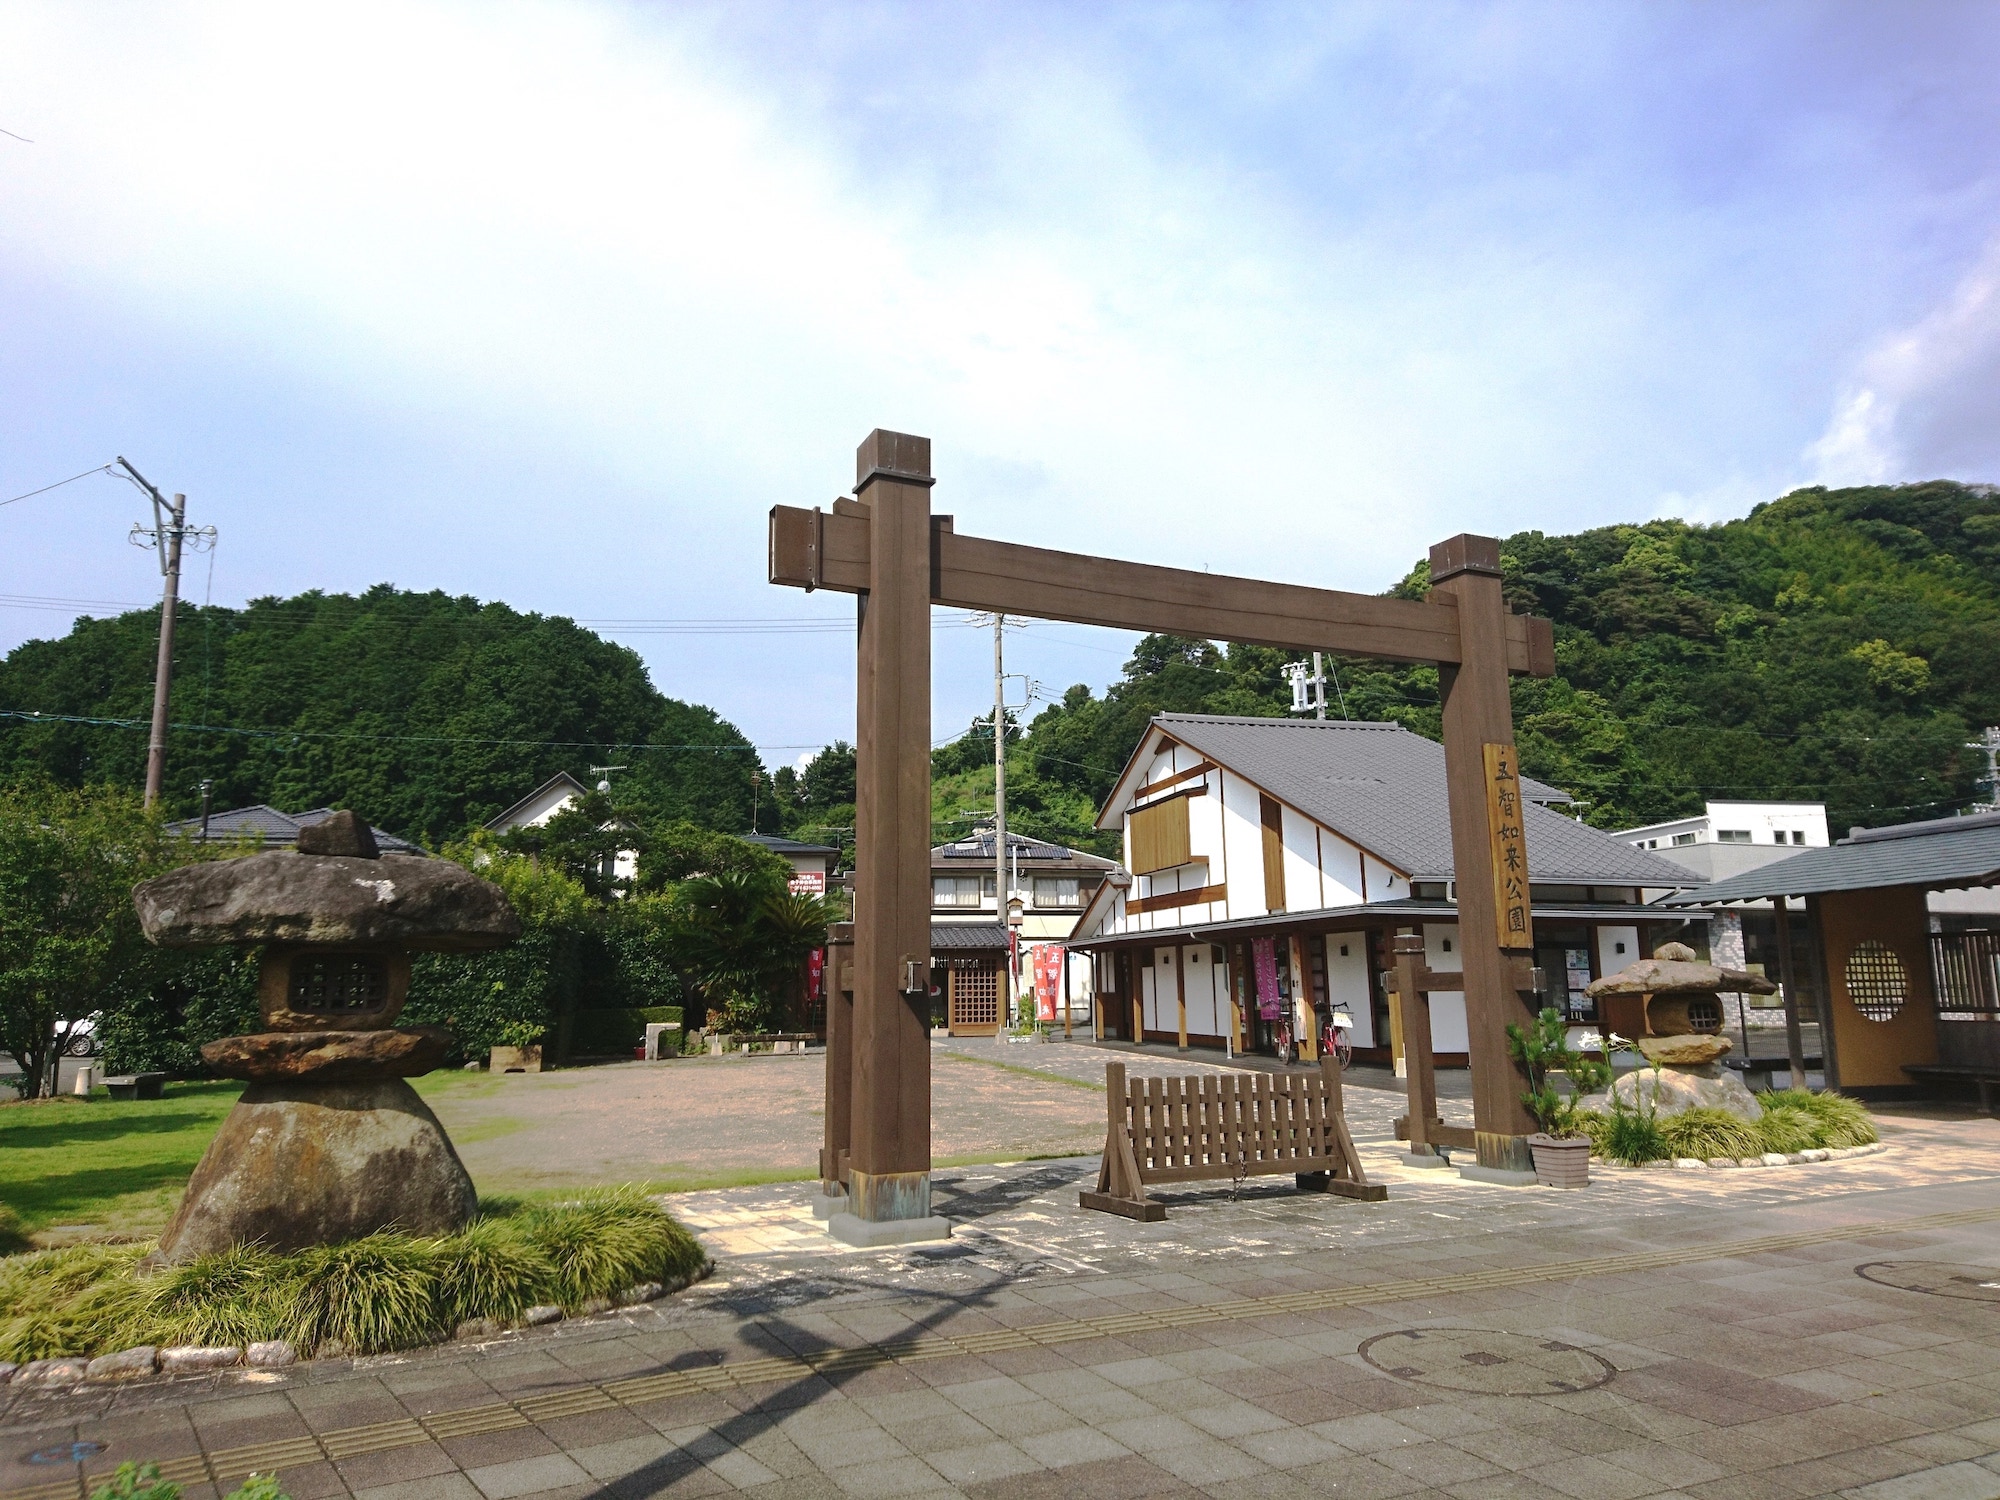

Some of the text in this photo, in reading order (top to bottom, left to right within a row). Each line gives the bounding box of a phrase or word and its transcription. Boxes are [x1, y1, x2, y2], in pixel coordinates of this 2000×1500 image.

[1495, 761, 1526, 933] 五智如来公園
